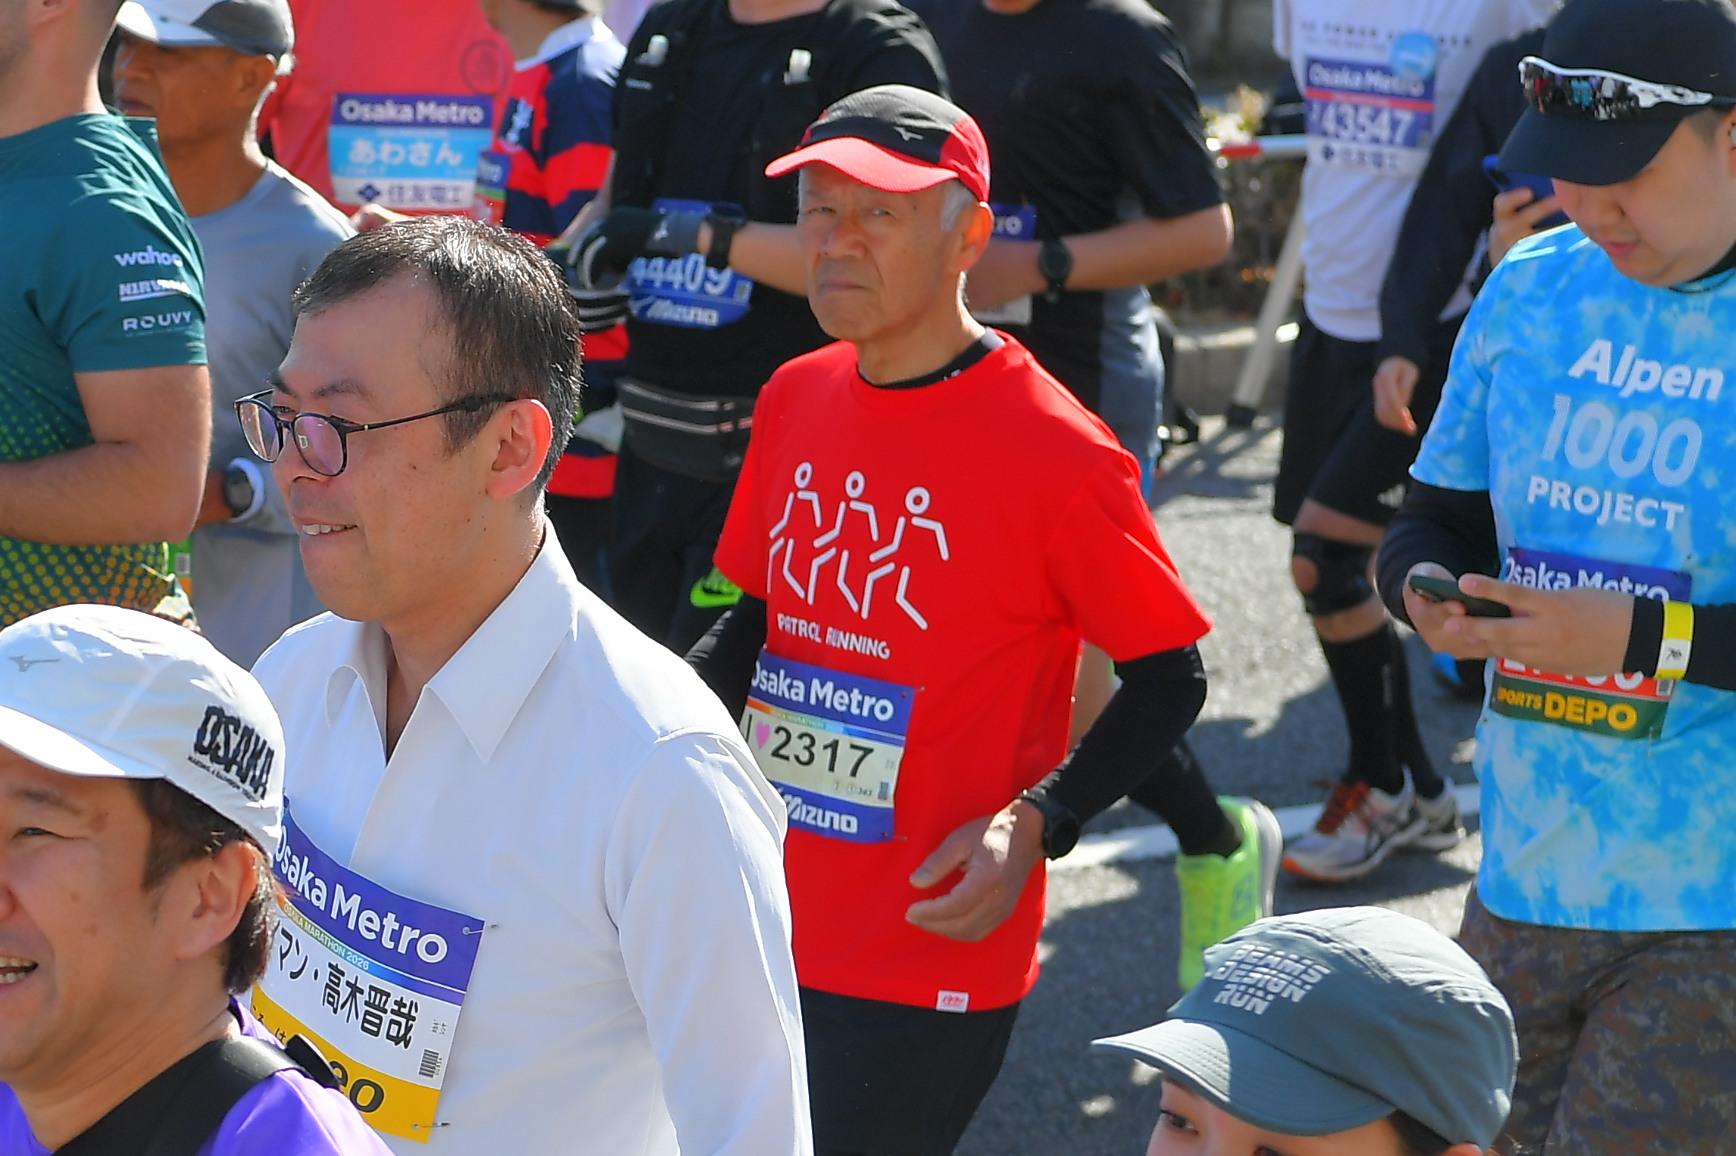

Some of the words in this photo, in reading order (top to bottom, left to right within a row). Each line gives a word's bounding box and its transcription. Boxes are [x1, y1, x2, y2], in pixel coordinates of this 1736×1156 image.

[340, 98, 414, 123] Osaka
[415, 100, 485, 125] Metro
[1320, 101, 1413, 146] 43547
[349, 139, 463, 167] あわさん
[123, 310, 192, 332] ROUVY
[1567, 338, 1724, 401] Alpen
[1540, 392, 1703, 487] 1000
[1527, 474, 1685, 531] PROJECT
[825, 627, 892, 661] RUNNING
[809, 677, 895, 722] Metro
[1543, 691, 1638, 731] DEPO
[193, 705, 275, 801] OSAKA
[770, 725, 875, 779] 2317
[275, 825, 327, 912] Osaka
[330, 883, 448, 964] Metro
[345, 951, 370, 971] 2026
